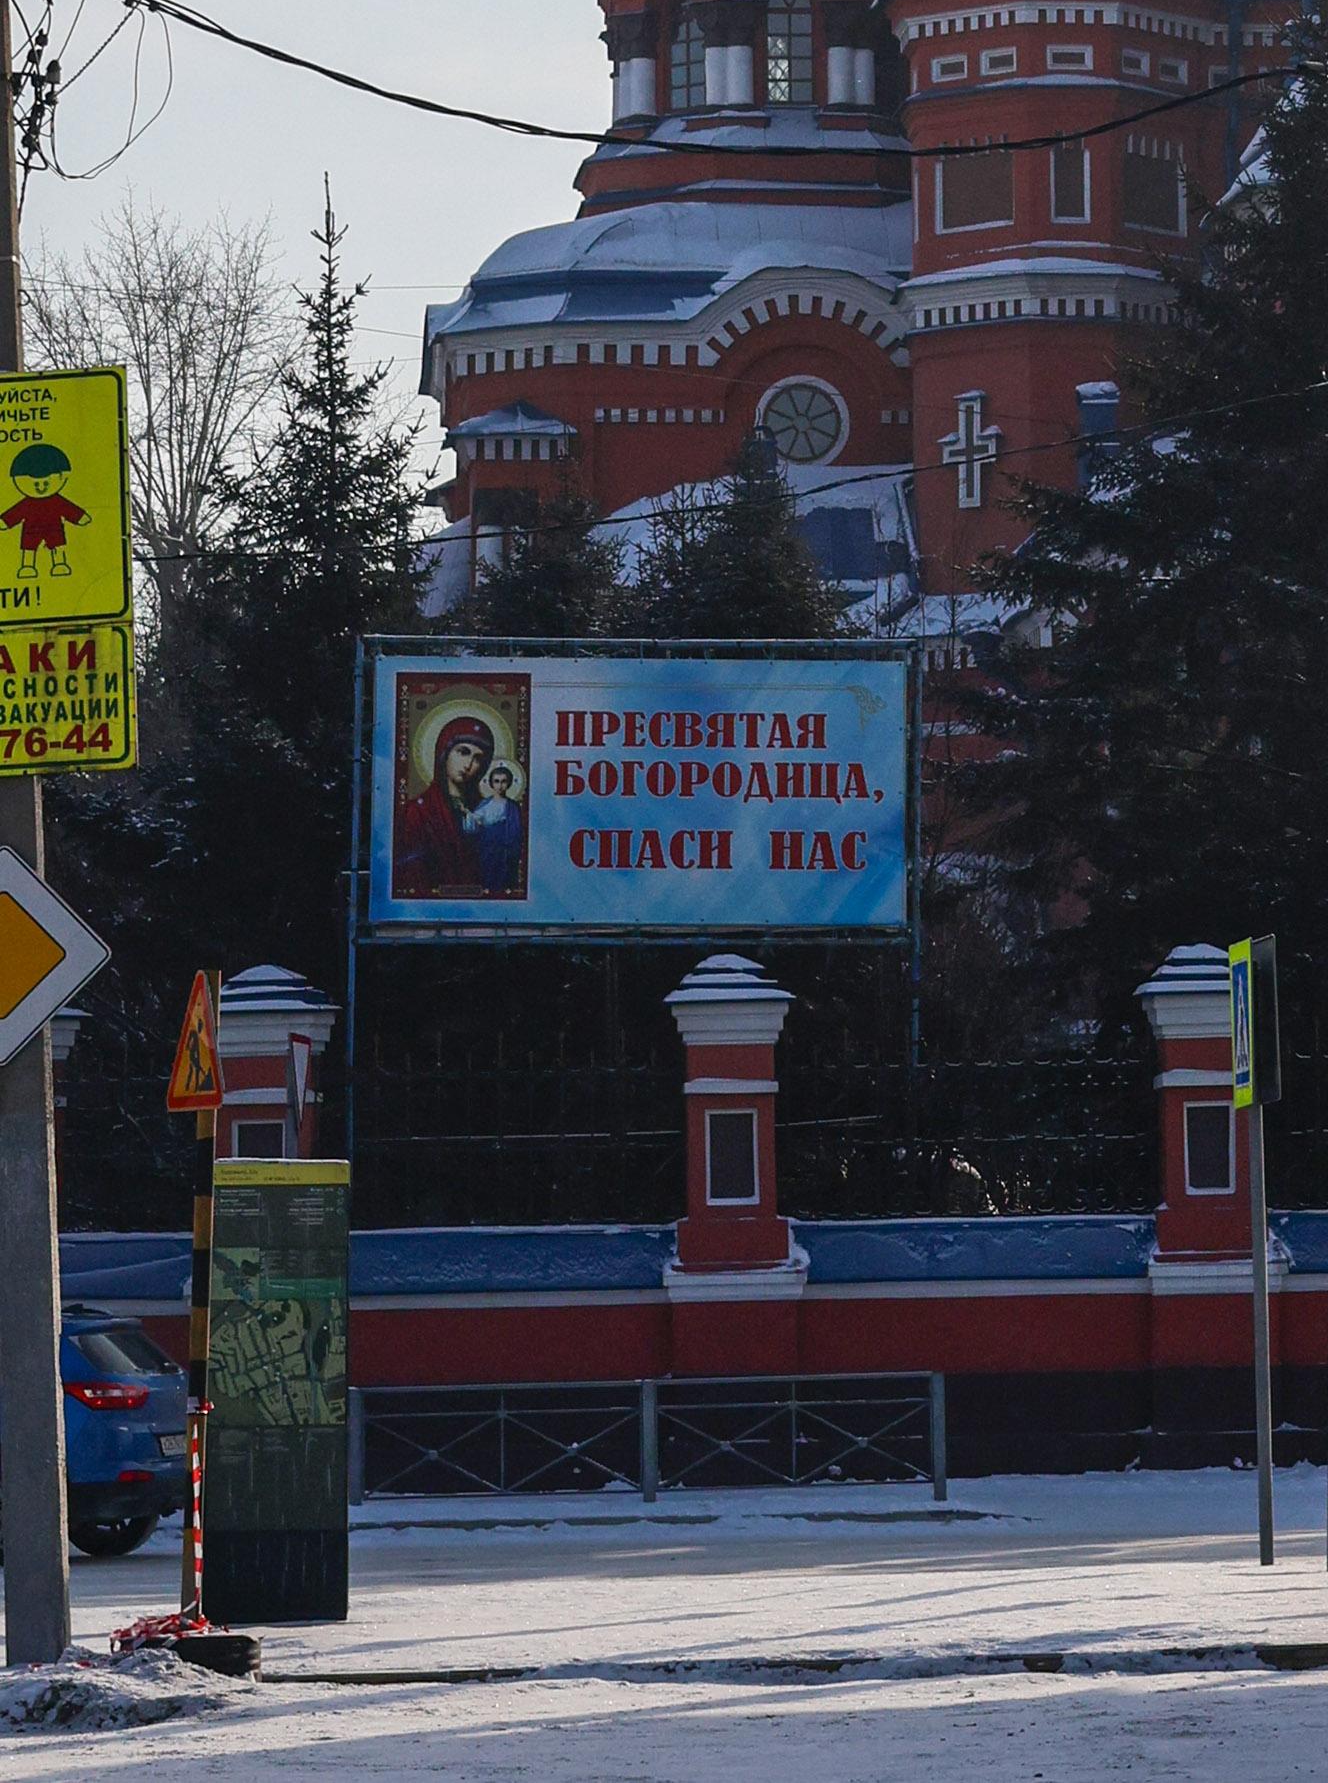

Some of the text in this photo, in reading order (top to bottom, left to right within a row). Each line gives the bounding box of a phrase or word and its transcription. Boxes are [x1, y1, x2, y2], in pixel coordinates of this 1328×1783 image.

[3, 673, 118, 699] СНОСТИ
[554, 710, 827, 749] ПРЕСВЯТАЯ
[553, 760, 885, 804] БОГОРОДИЦА,
[568, 829, 868, 871] СПАСИ НАС
